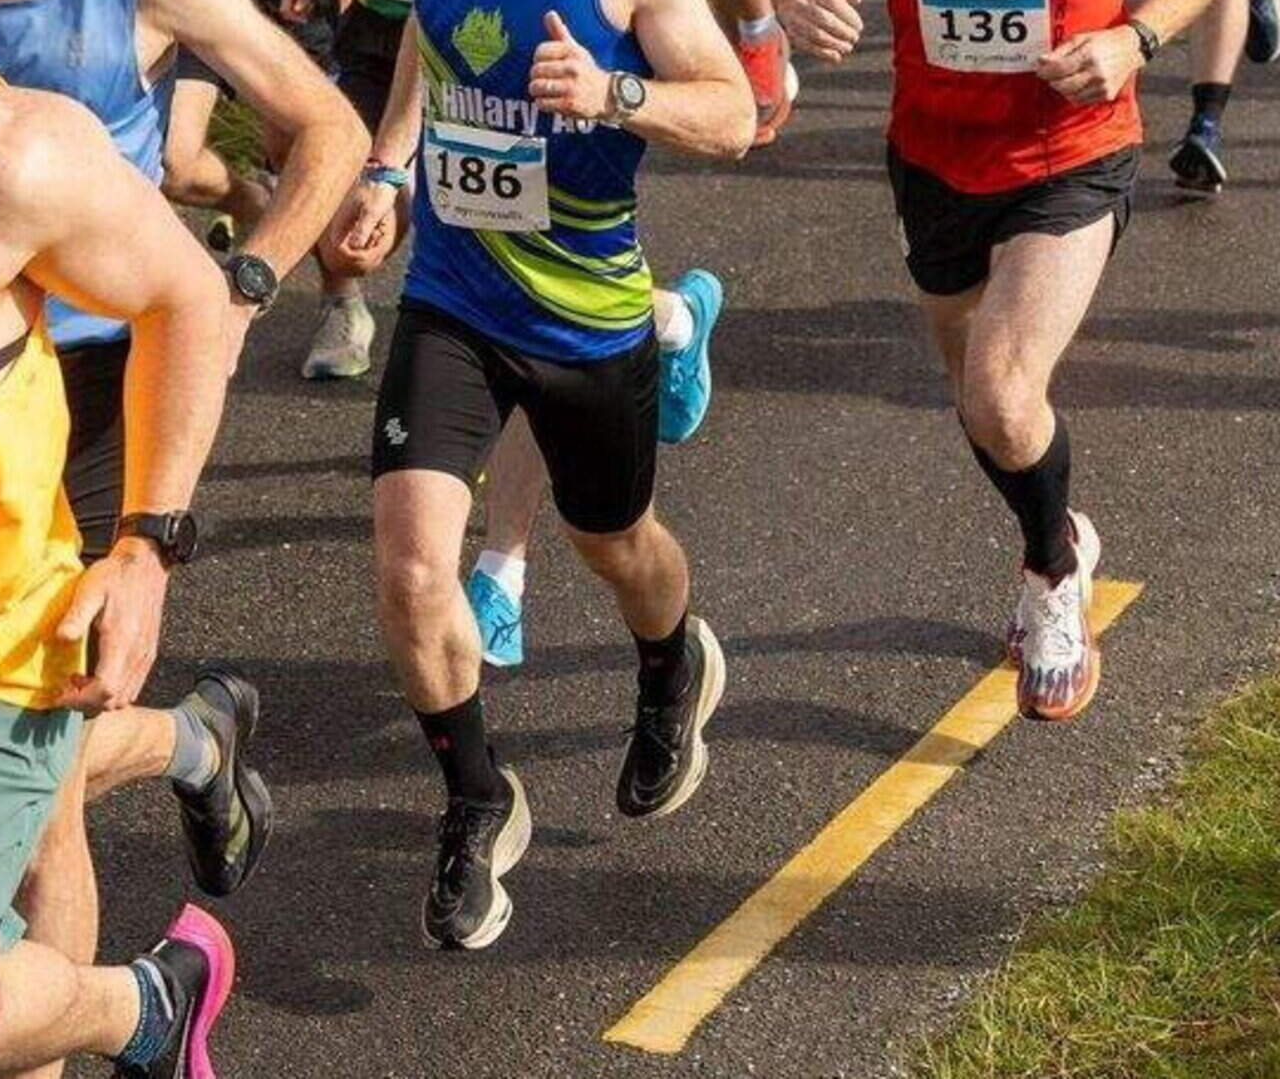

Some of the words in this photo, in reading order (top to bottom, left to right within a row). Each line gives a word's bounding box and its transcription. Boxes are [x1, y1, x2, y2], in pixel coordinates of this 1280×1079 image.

[939, 9, 1028, 44] 136
[442, 80, 539, 137] Hillary
[437, 150, 521, 200] 186
